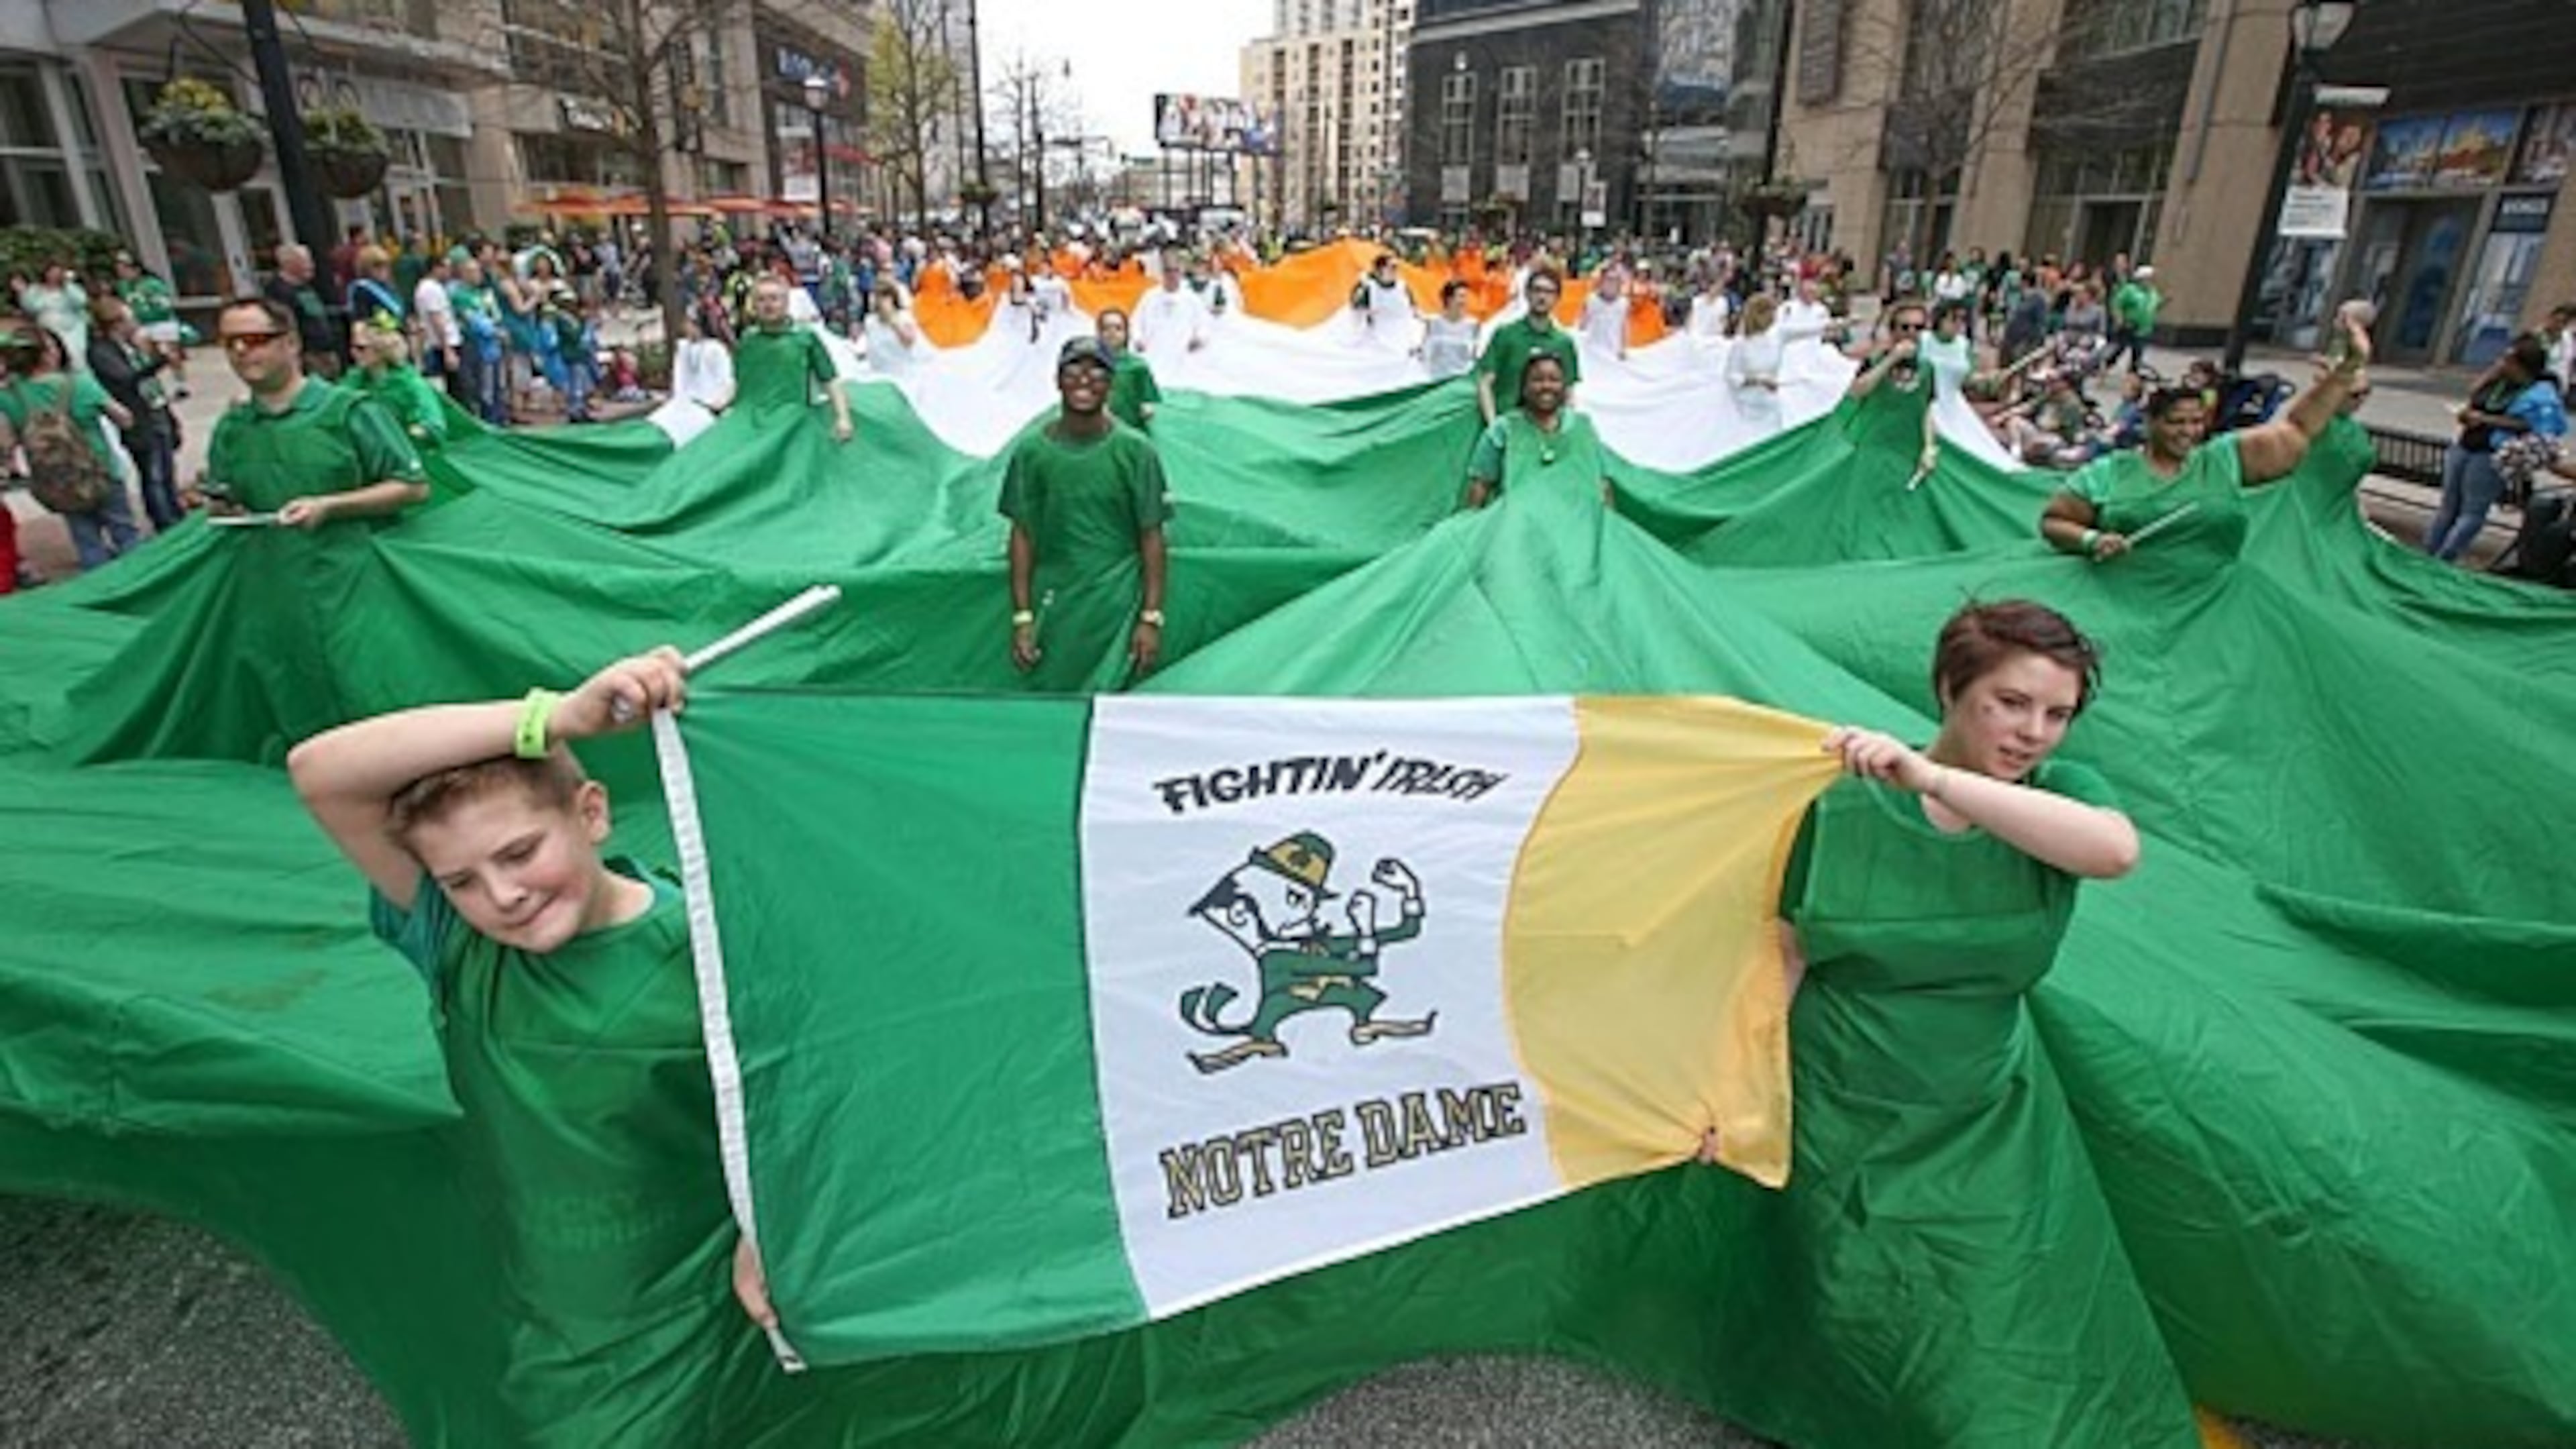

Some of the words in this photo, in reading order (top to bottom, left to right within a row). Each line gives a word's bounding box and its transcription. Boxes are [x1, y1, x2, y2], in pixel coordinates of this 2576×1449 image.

[1152, 749, 1387, 814] FIGHTIN'
[1370, 757, 1511, 803] IRISH
[1159, 1108, 1354, 1219] NOTRE
[1355, 1081, 1527, 1169] DAME
